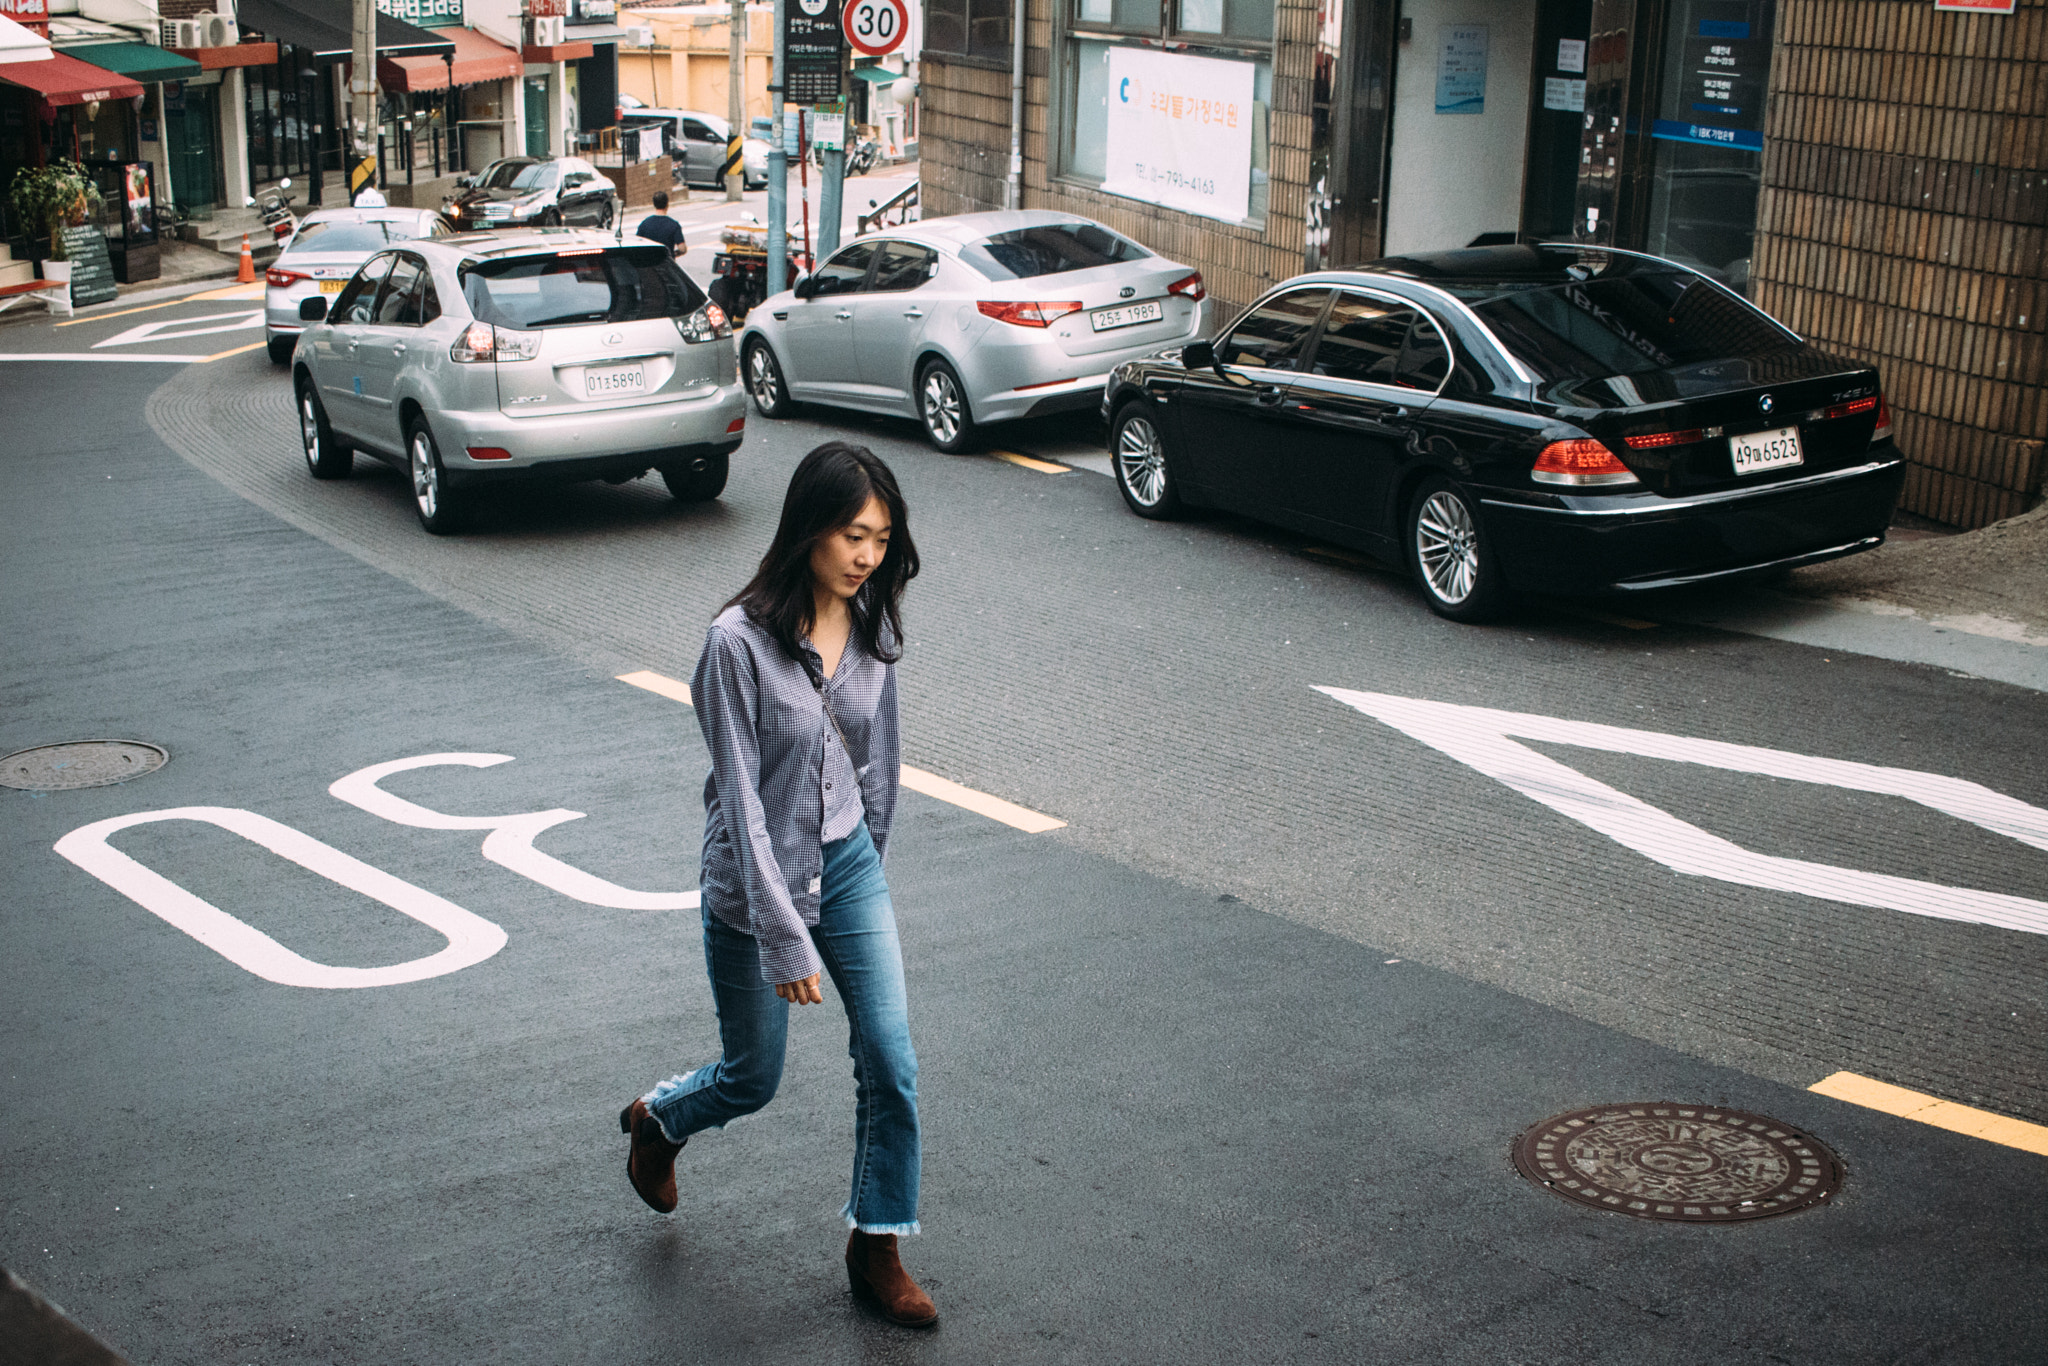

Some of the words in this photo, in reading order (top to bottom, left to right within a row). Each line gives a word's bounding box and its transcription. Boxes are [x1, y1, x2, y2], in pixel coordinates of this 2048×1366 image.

[858, 5, 894, 38] 30
[1121, 288, 1135, 297] KIA
[1127, 304, 1155, 320] 1989
